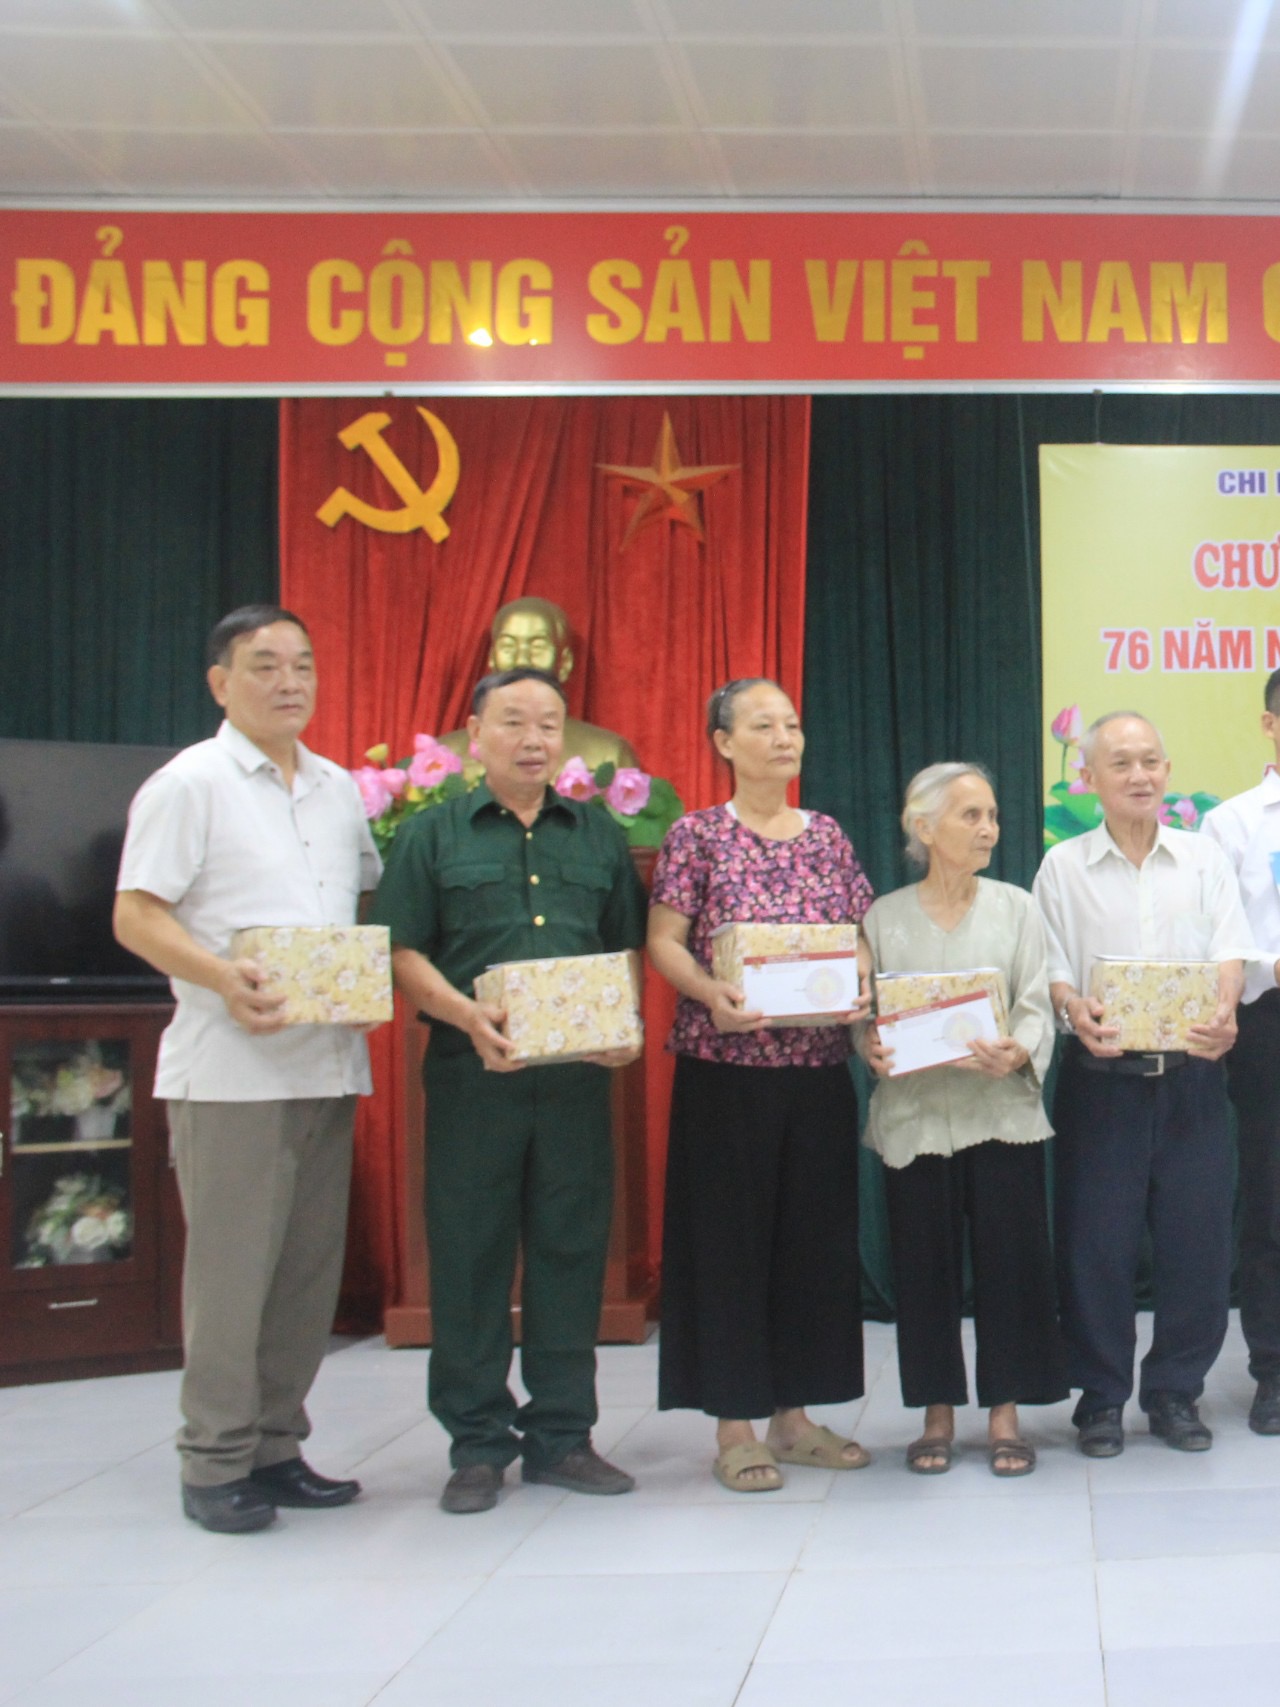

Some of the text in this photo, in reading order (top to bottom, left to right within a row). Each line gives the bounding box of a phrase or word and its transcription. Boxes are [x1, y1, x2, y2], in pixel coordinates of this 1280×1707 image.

[12, 225, 270, 347] ĐẢNG
[306, 238, 554, 367] CỘNG
[586, 225, 771, 345] SẢN
[804, 239, 992, 361] VIỆT
[1021, 259, 1229, 344] NAM
[1218, 471, 1266, 494] CHI
[1103, 630, 1150, 670] 76
[1163, 620, 1253, 670] NĂM
